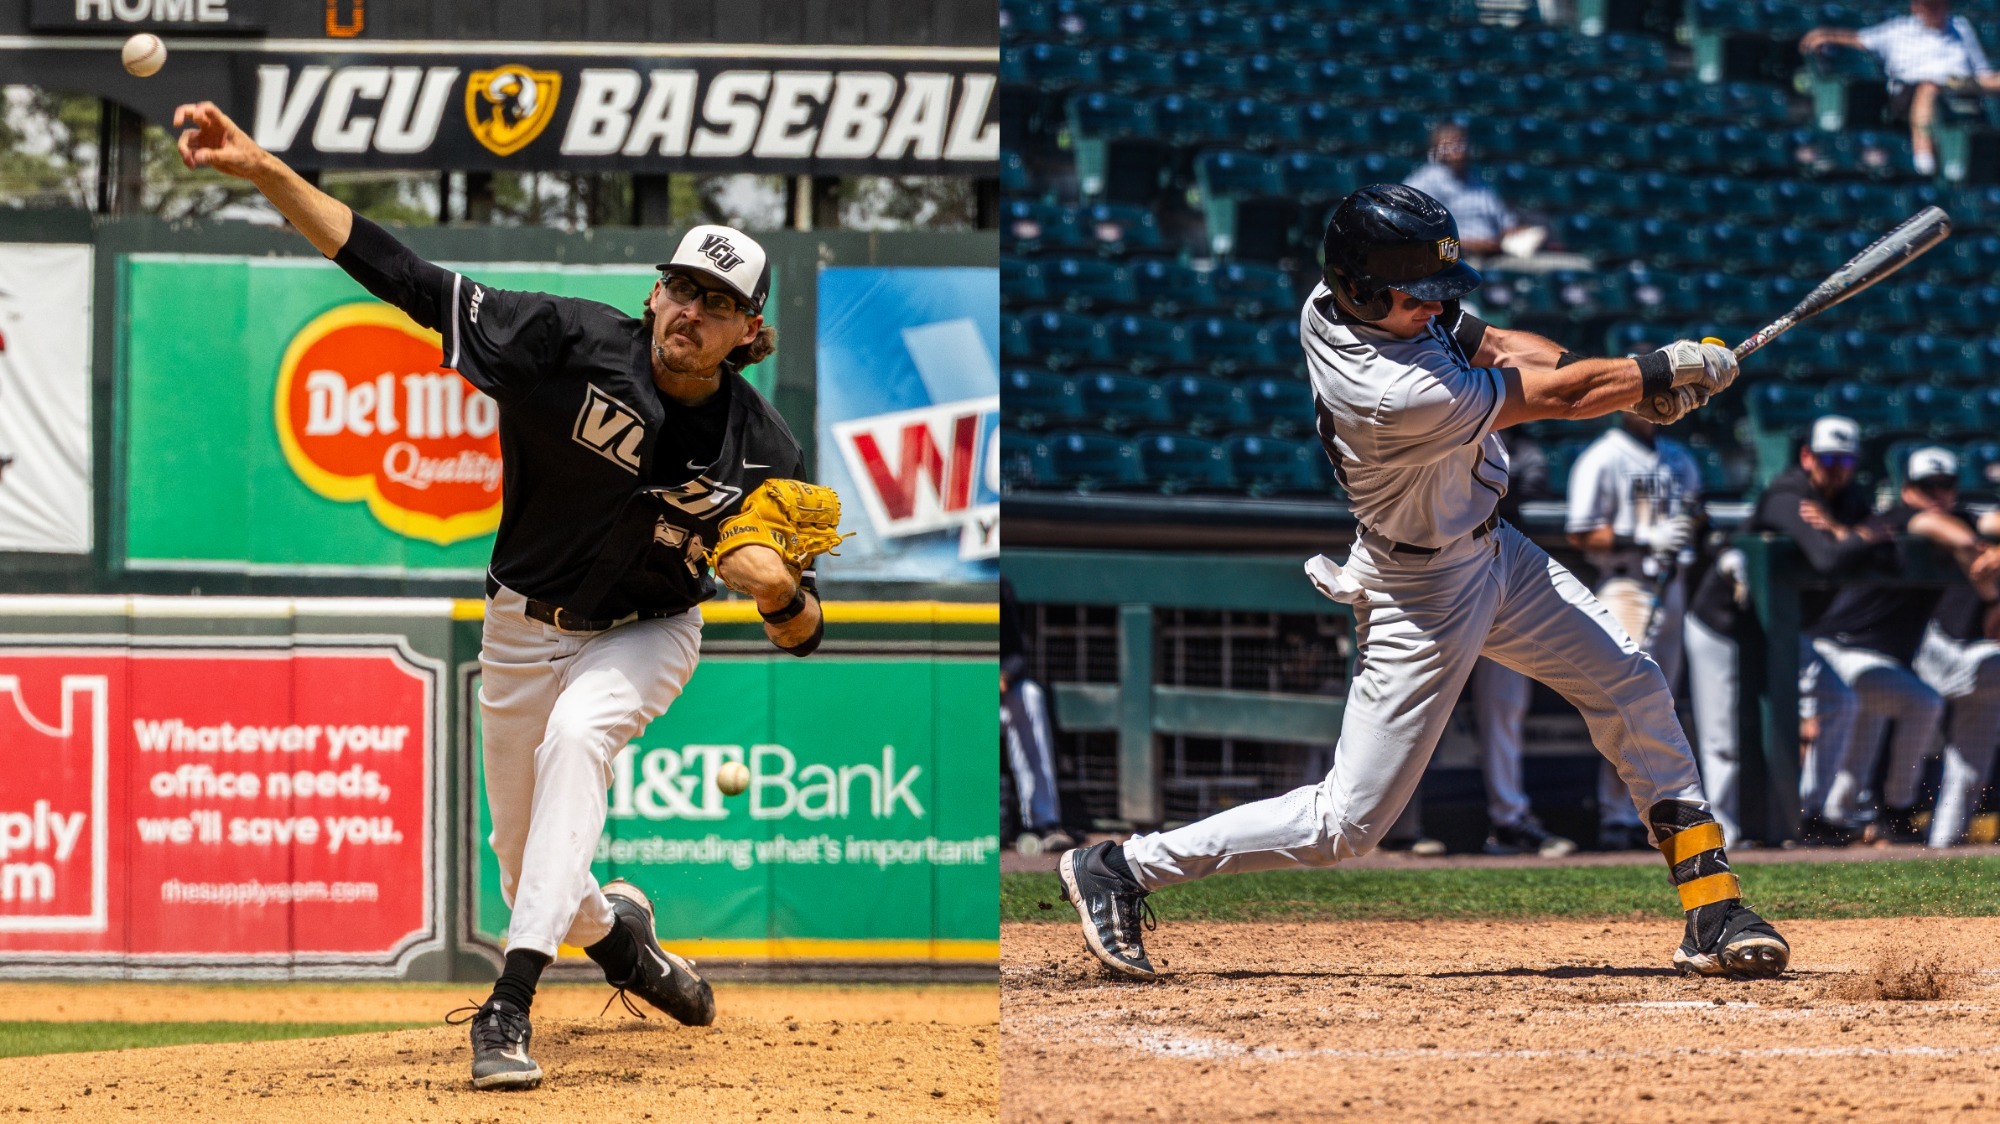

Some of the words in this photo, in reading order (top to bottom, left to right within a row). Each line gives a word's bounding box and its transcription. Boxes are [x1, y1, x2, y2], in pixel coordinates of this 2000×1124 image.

[254, 65, 461, 153] VCU
[560, 69, 999, 160] BASEBAL
[697, 233, 745, 272] VCU
[1437, 236, 1460, 262] VCU
[304, 369, 401, 437] Del
[382, 440, 503, 493] Quality
[133, 717, 322, 753] Whatever
[325, 724, 410, 761] your
[150, 763, 261, 798] office
[266, 763, 391, 804] needs,
[748, 743, 926, 821] Bank
[136, 809, 223, 844] we'll
[228, 815, 320, 845] save
[325, 815, 404, 855] you.
[755, 833, 843, 865] what's
[160, 877, 379, 908] thesupplyroom.com
